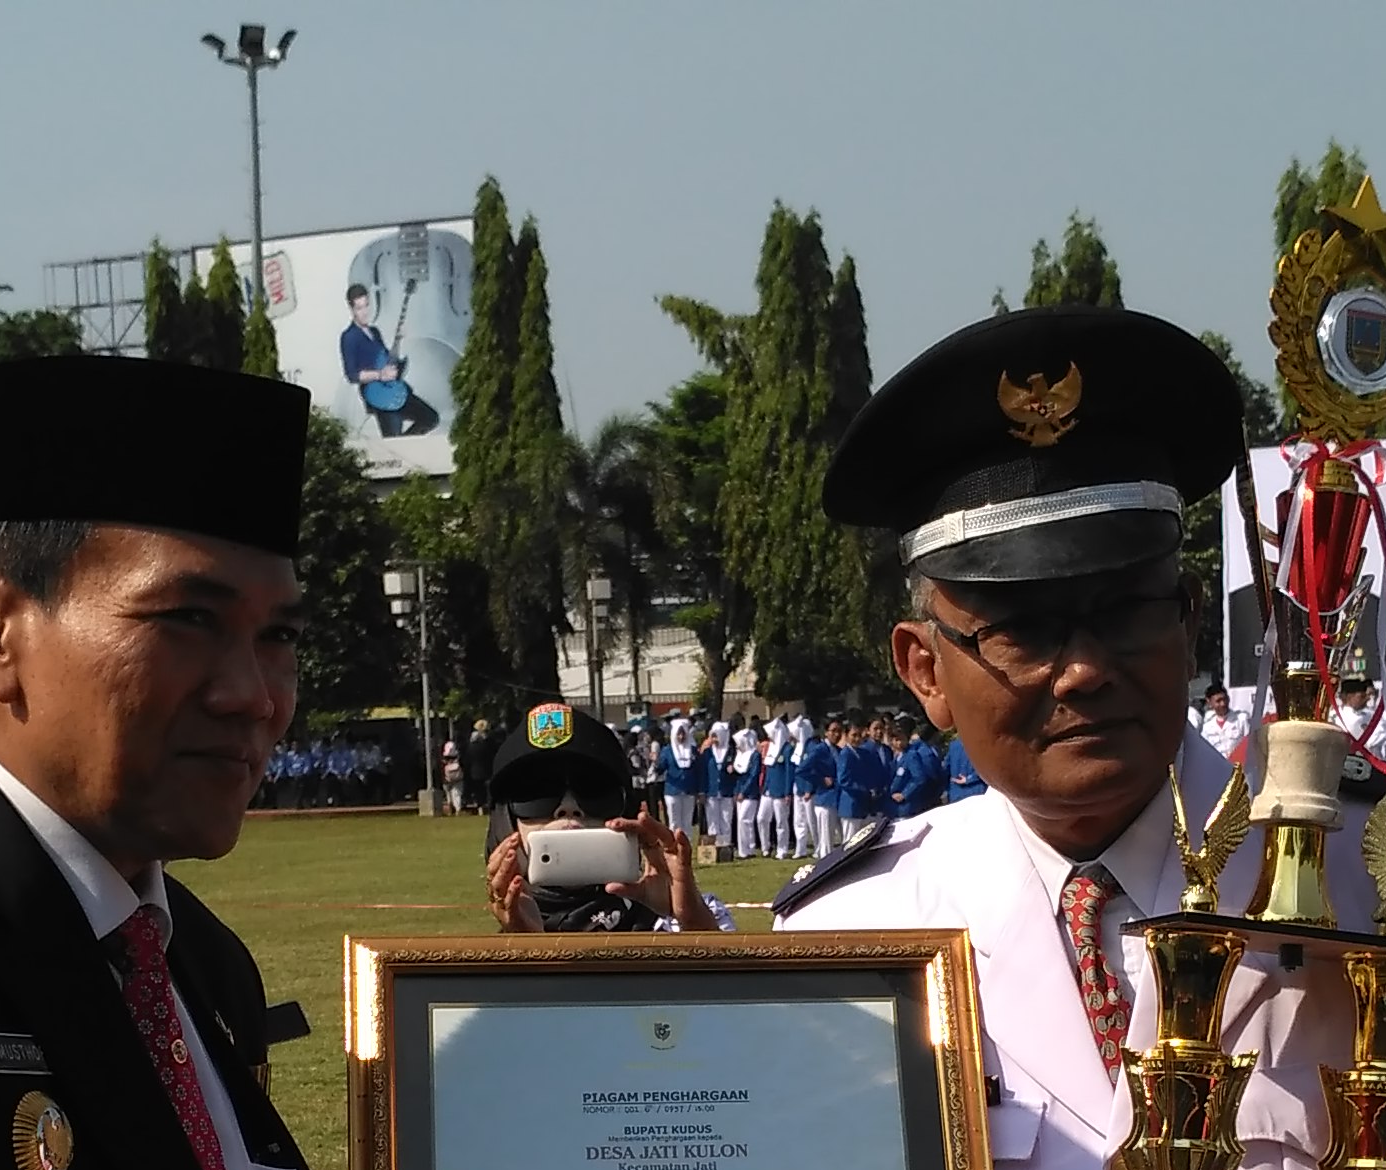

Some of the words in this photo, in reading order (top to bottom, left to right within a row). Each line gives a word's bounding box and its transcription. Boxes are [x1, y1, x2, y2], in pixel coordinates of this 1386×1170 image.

[582, 1092, 639, 1103] PIAGAM
[643, 1090, 749, 1102] PENGHARGAAN
[624, 1126, 668, 1135] BUPATI
[671, 1125, 713, 1134] KUDUS
[586, 1146, 635, 1160] DESA
[639, 1145, 678, 1159] JATI
[684, 1144, 749, 1158] KULON
[693, 1161, 718, 1170] Jati
